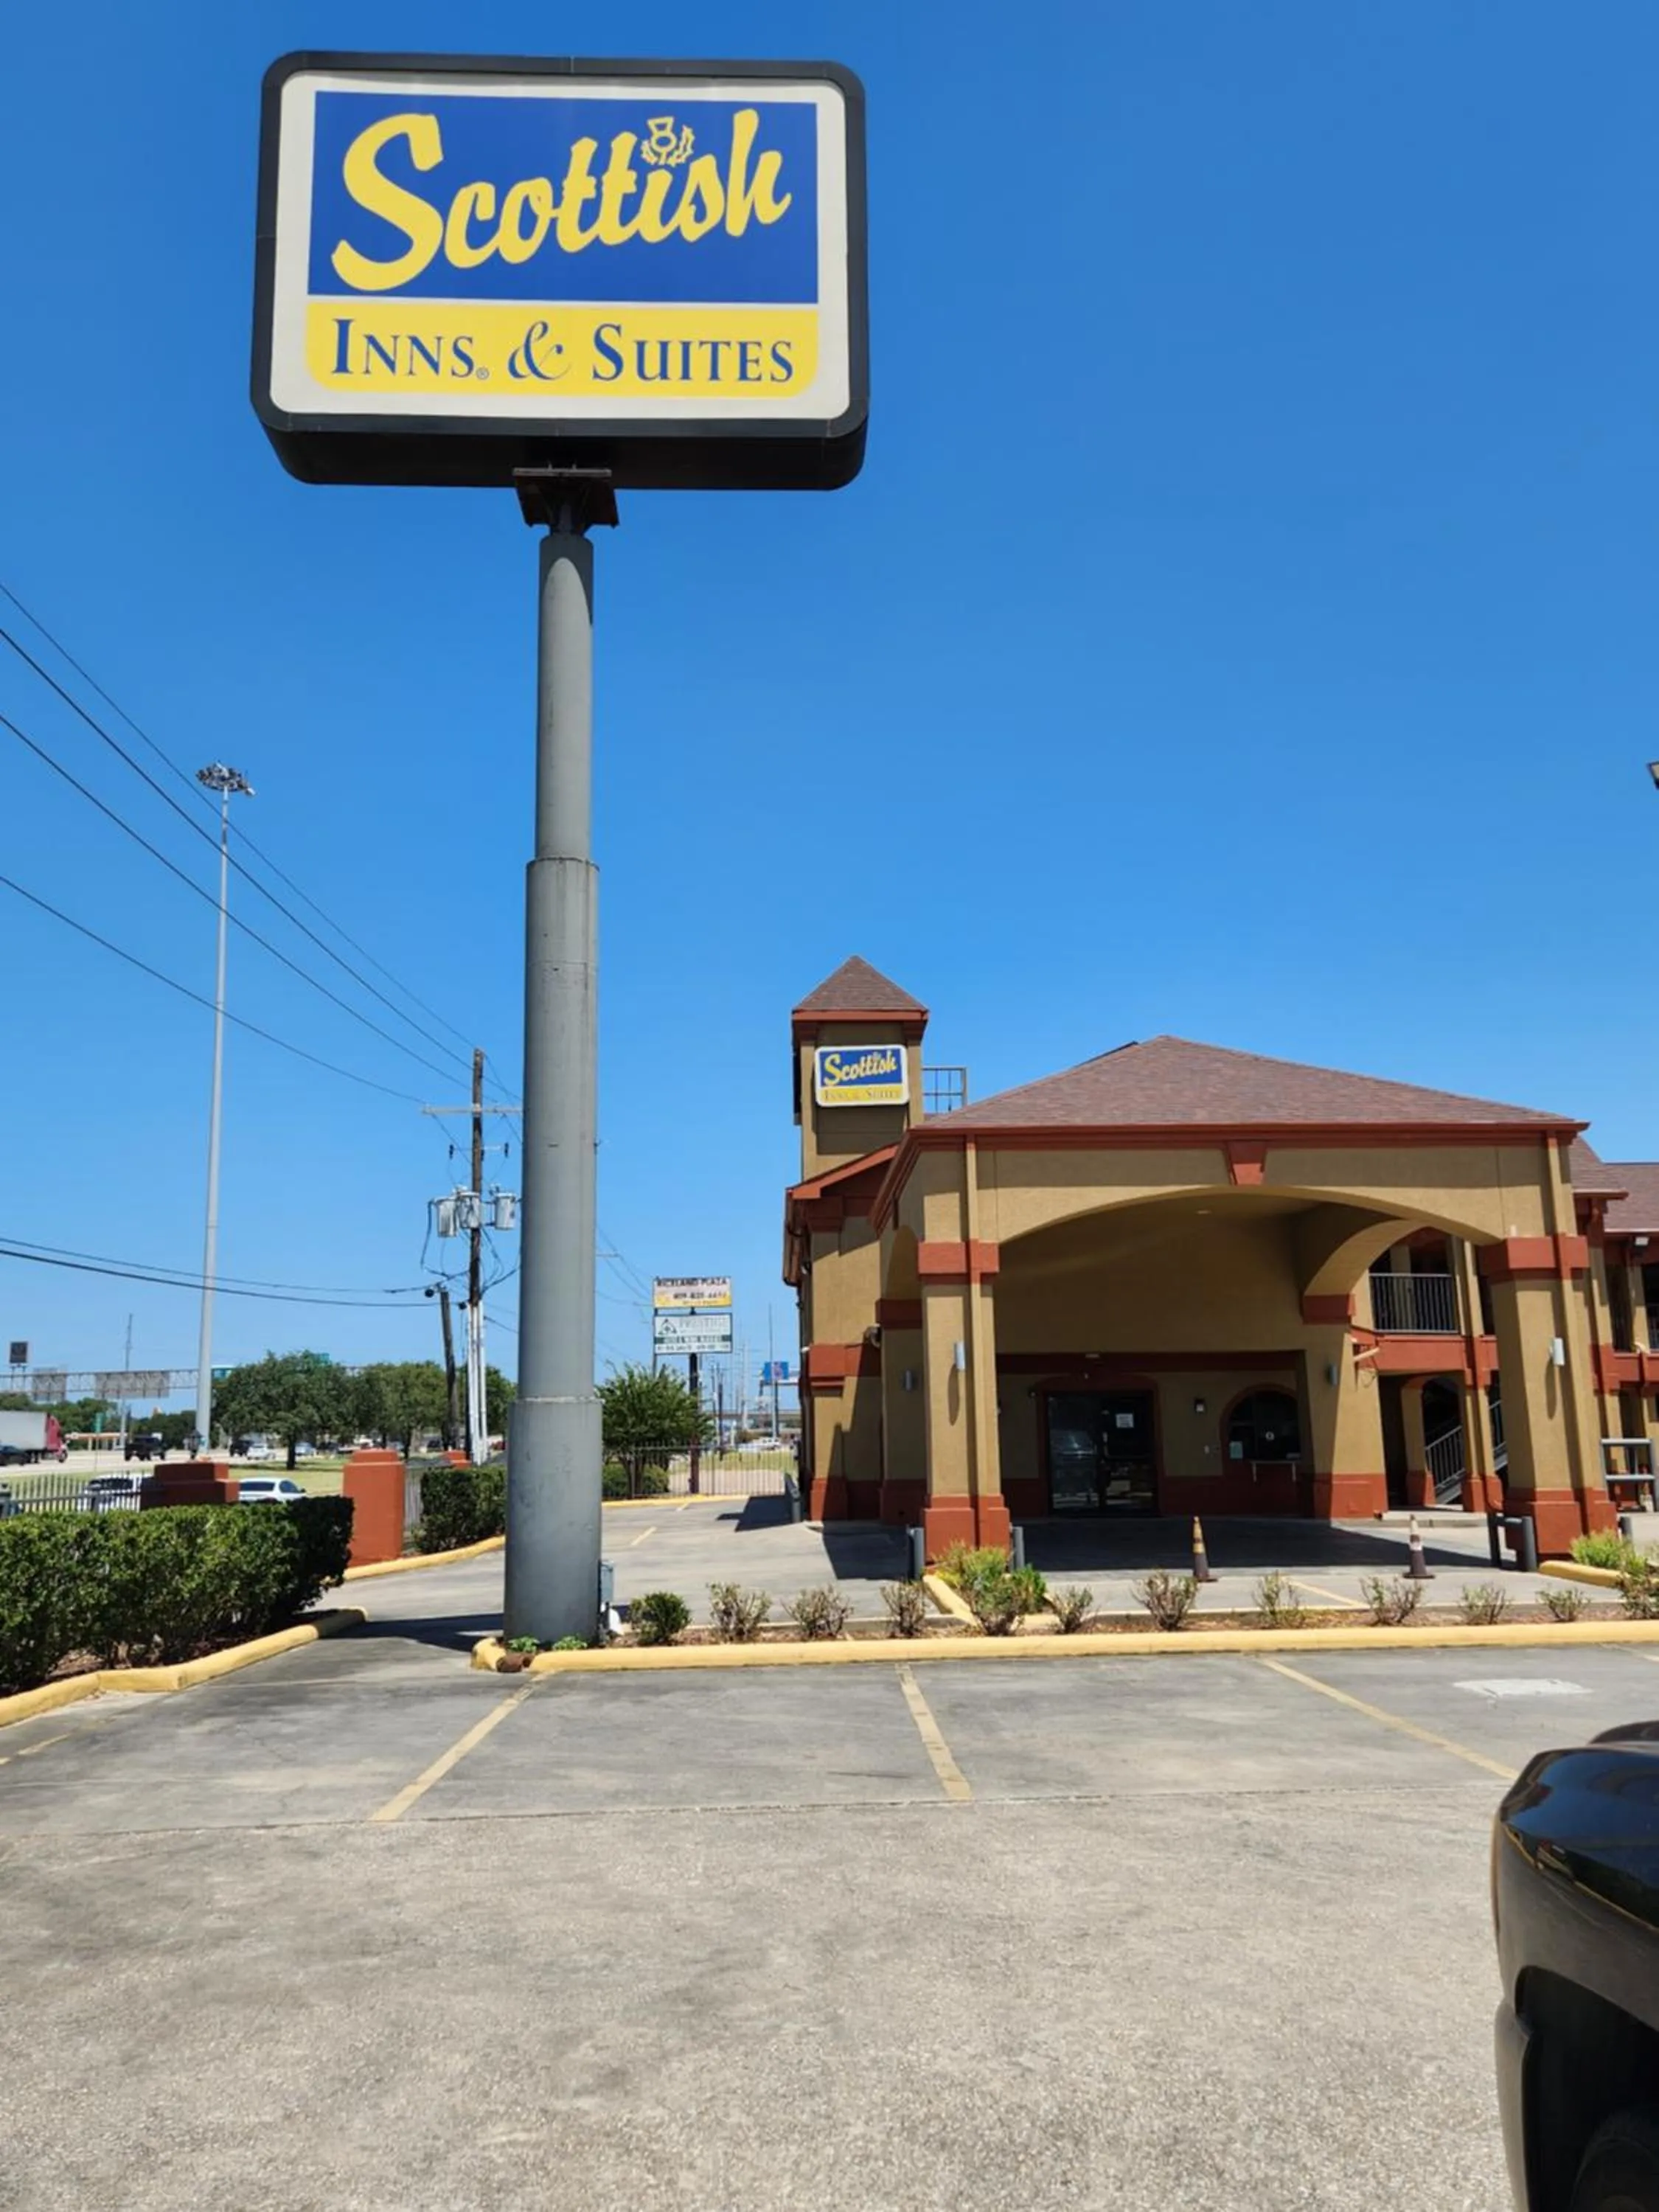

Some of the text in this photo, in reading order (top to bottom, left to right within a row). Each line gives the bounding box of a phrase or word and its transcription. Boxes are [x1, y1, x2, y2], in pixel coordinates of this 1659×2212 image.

[331, 108, 791, 291] Scottish
[507, 320, 572, 380] &
[593, 323, 794, 384] SUITES
[824, 1049, 897, 1086] Scottish
